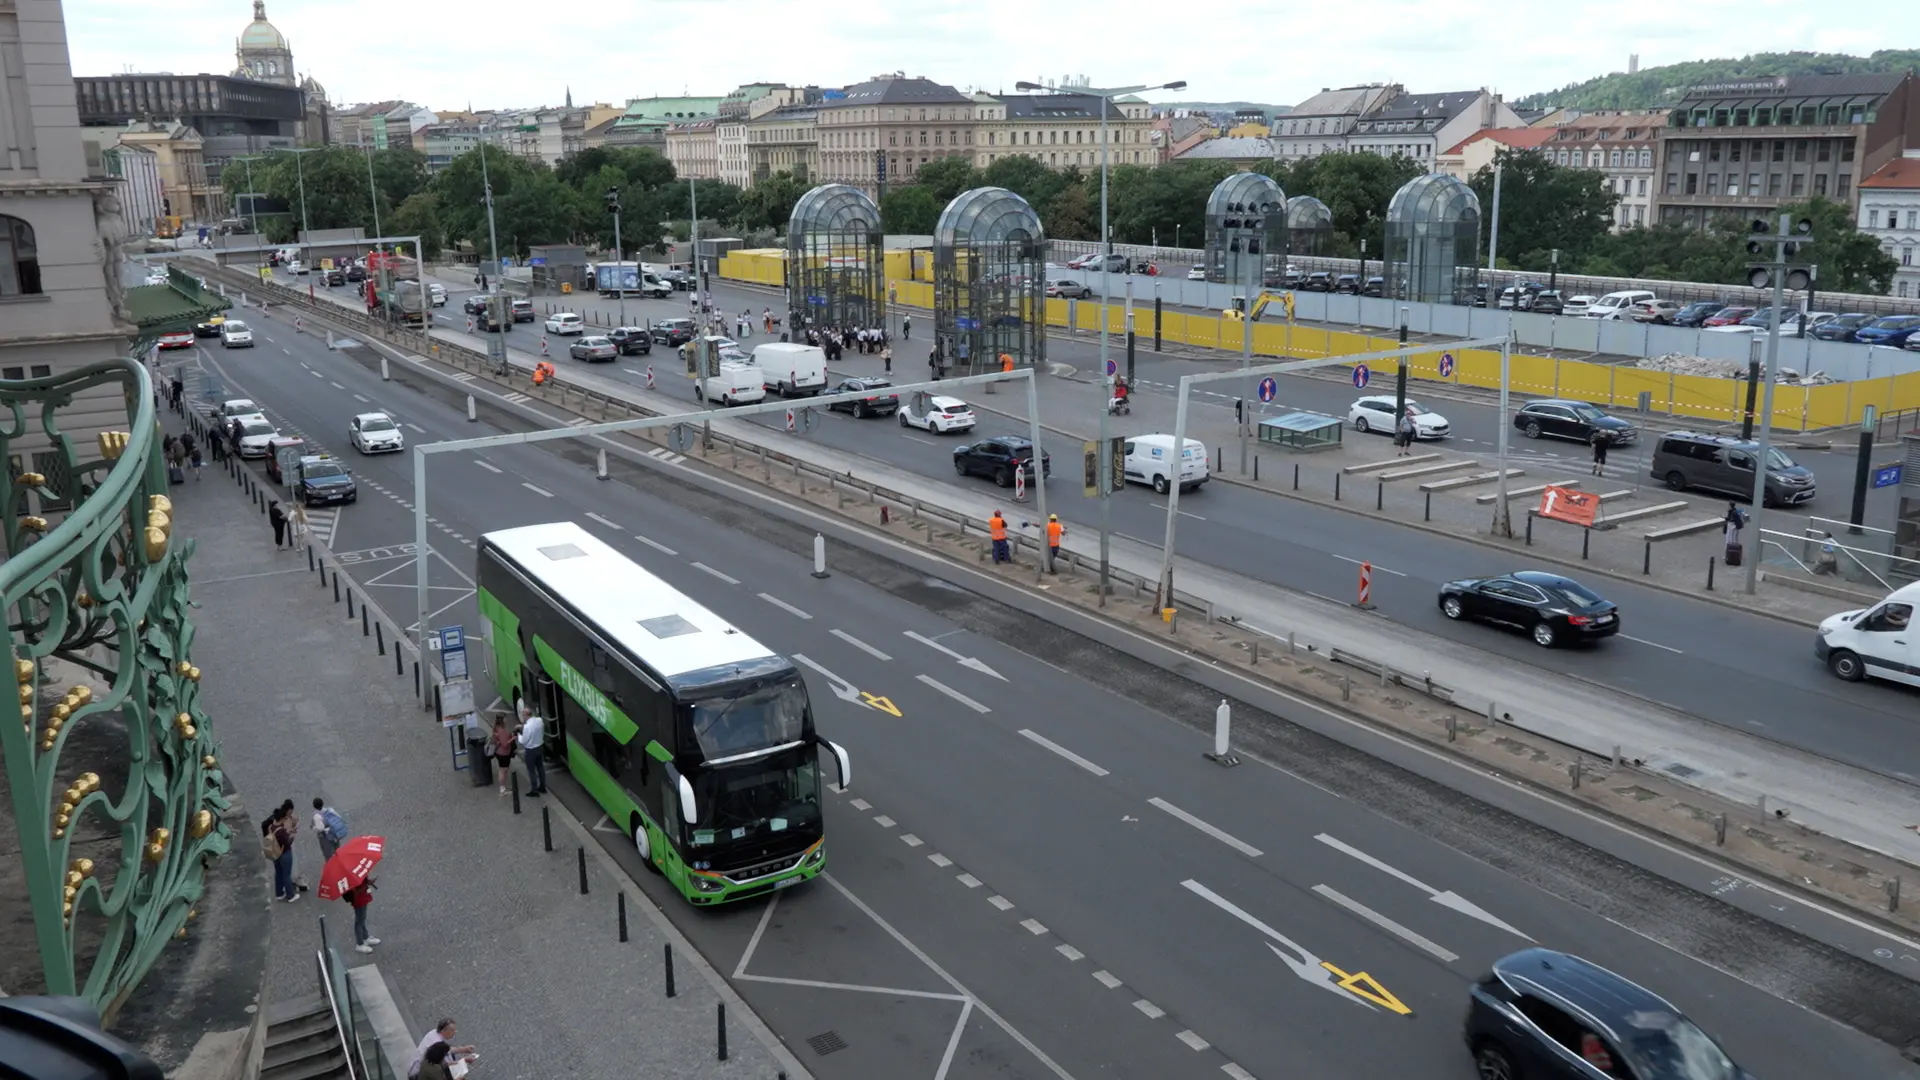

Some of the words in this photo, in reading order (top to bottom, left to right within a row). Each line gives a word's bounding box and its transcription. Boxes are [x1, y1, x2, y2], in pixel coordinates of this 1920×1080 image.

[340, 543, 420, 562] BUS
[433, 641, 438, 649] 1
[739, 860, 793, 878] SETRA
